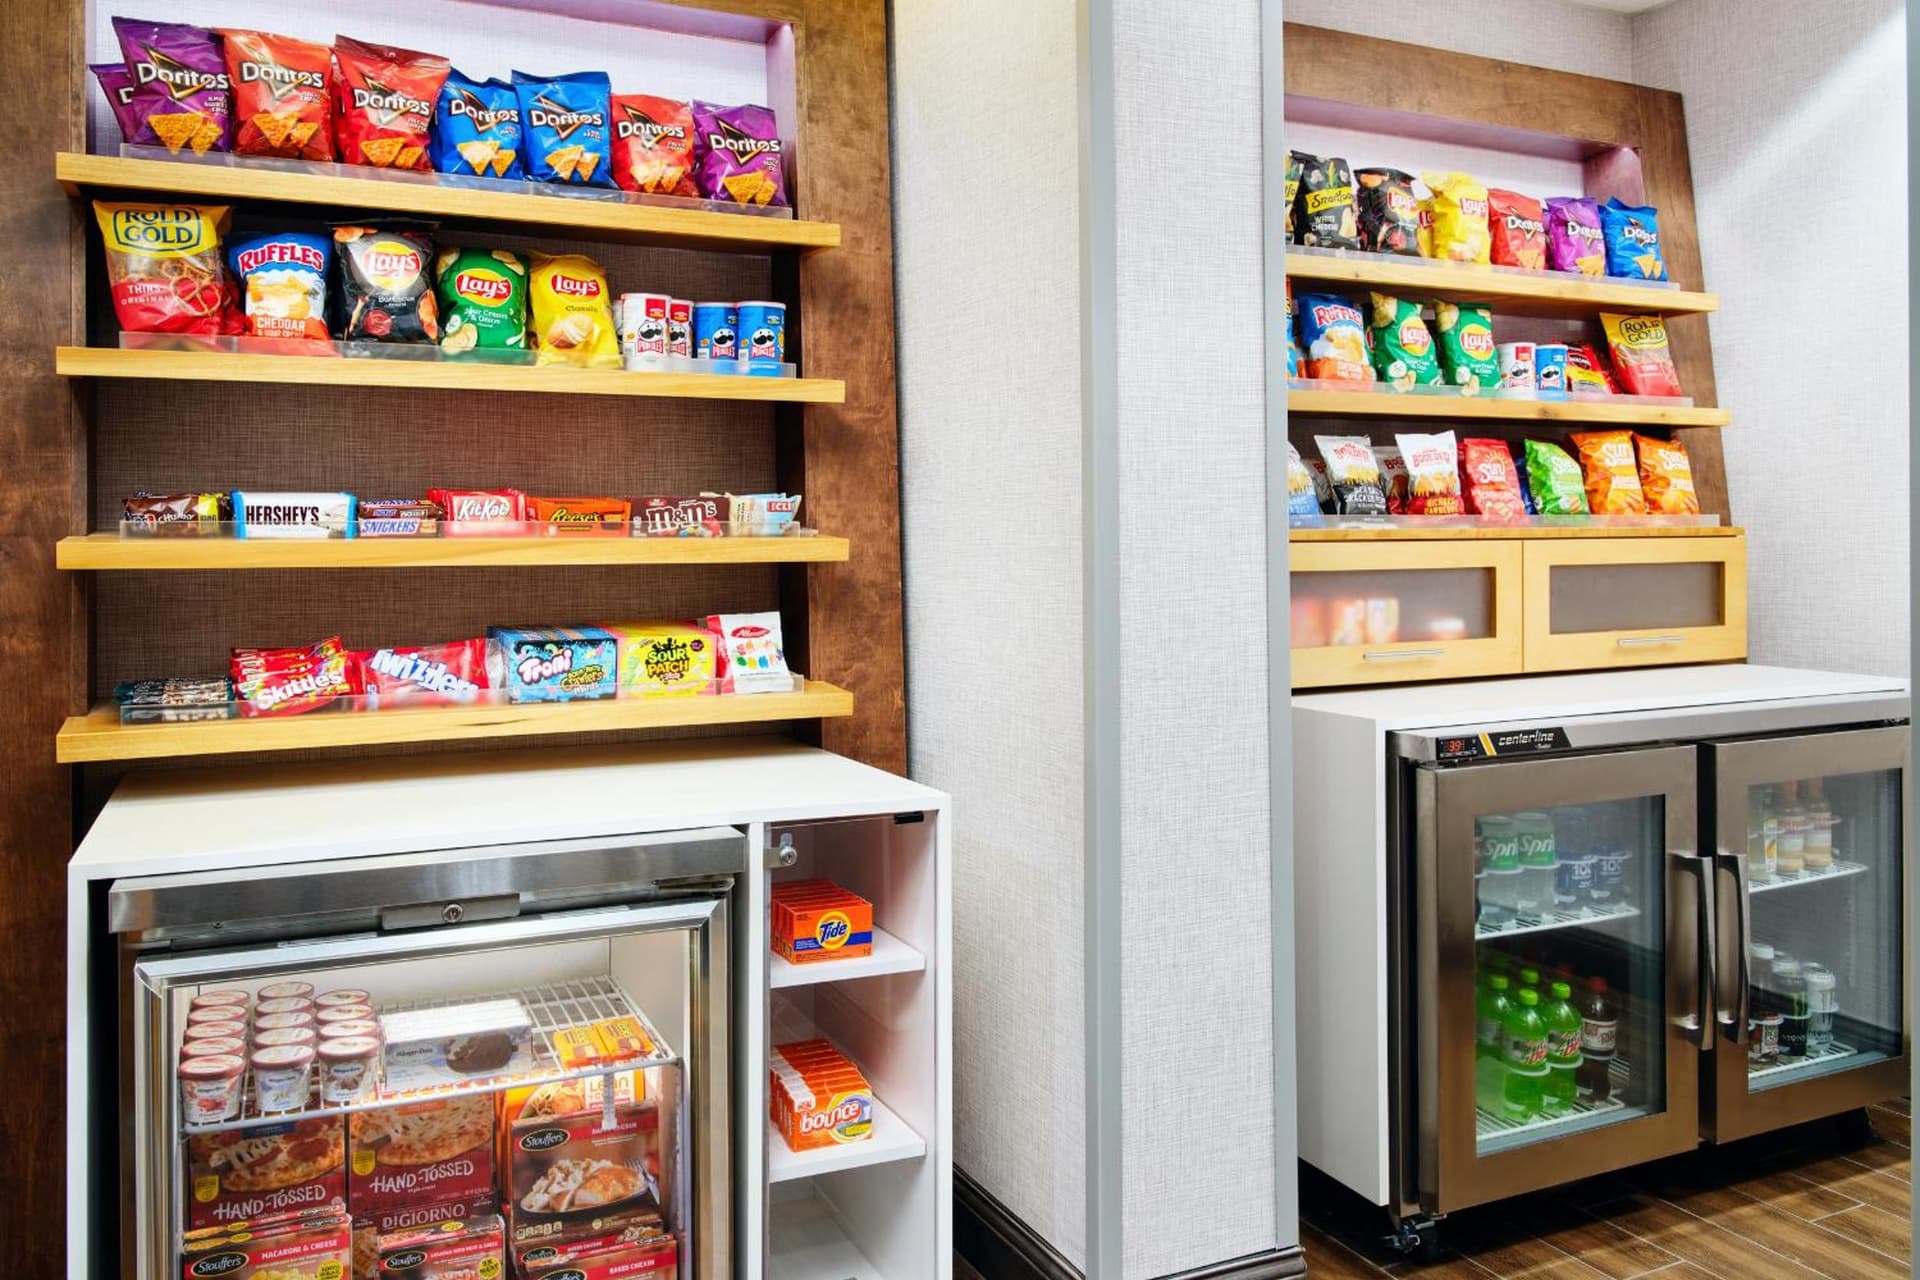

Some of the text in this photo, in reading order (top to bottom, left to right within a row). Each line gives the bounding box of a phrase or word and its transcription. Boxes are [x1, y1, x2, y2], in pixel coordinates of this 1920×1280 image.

[136, 63, 229, 90] Doritos
[242, 62, 324, 89] Doritos
[354, 88, 430, 116] Doritos
[451, 99, 519, 124] Doritos
[531, 109, 602, 128] Doritos
[618, 121, 685, 139] Doritos
[709, 135, 781, 153] Doritos
[125, 209, 192, 225] ROLD
[124, 225, 193, 244] GOLD
[240, 244, 324, 274] RUFFLES
[368, 251, 417, 279] Lay's
[128, 284, 161, 295] THINS
[459, 273, 510, 297] Lay's
[551, 273, 598, 295] Lay's
[256, 317, 306, 330] CHEDDAR
[1403, 326, 1431, 346] Lay's
[1463, 332, 1493, 351] Lay's
[1628, 329, 1665, 343] GOLD
[245, 504, 319, 526] HERSHEY'S
[550, 507, 601, 524] Reese's
[363, 520, 418, 533] SNICKERS
[518, 648, 572, 684] Trolli
[648, 650, 687, 663] SOUR
[647, 661, 689, 675] PATCH
[255, 671, 344, 710] Skittles
[1498, 730, 1555, 746] centerline
[1483, 838, 1518, 860] Spri
[1520, 834, 1554, 856] Spri
[820, 921, 848, 944] Tide
[589, 1076, 629, 1092] Len
[801, 1102, 861, 1134] bounce
[369, 1161, 475, 1194] HAND-TOSSED
[212, 1184, 326, 1221] HAND-TOSSED
[261, 1246, 302, 1260] MACARONI
[310, 1239, 338, 1251] CHEESE
[198, 1255, 242, 1274] Stouffer's
